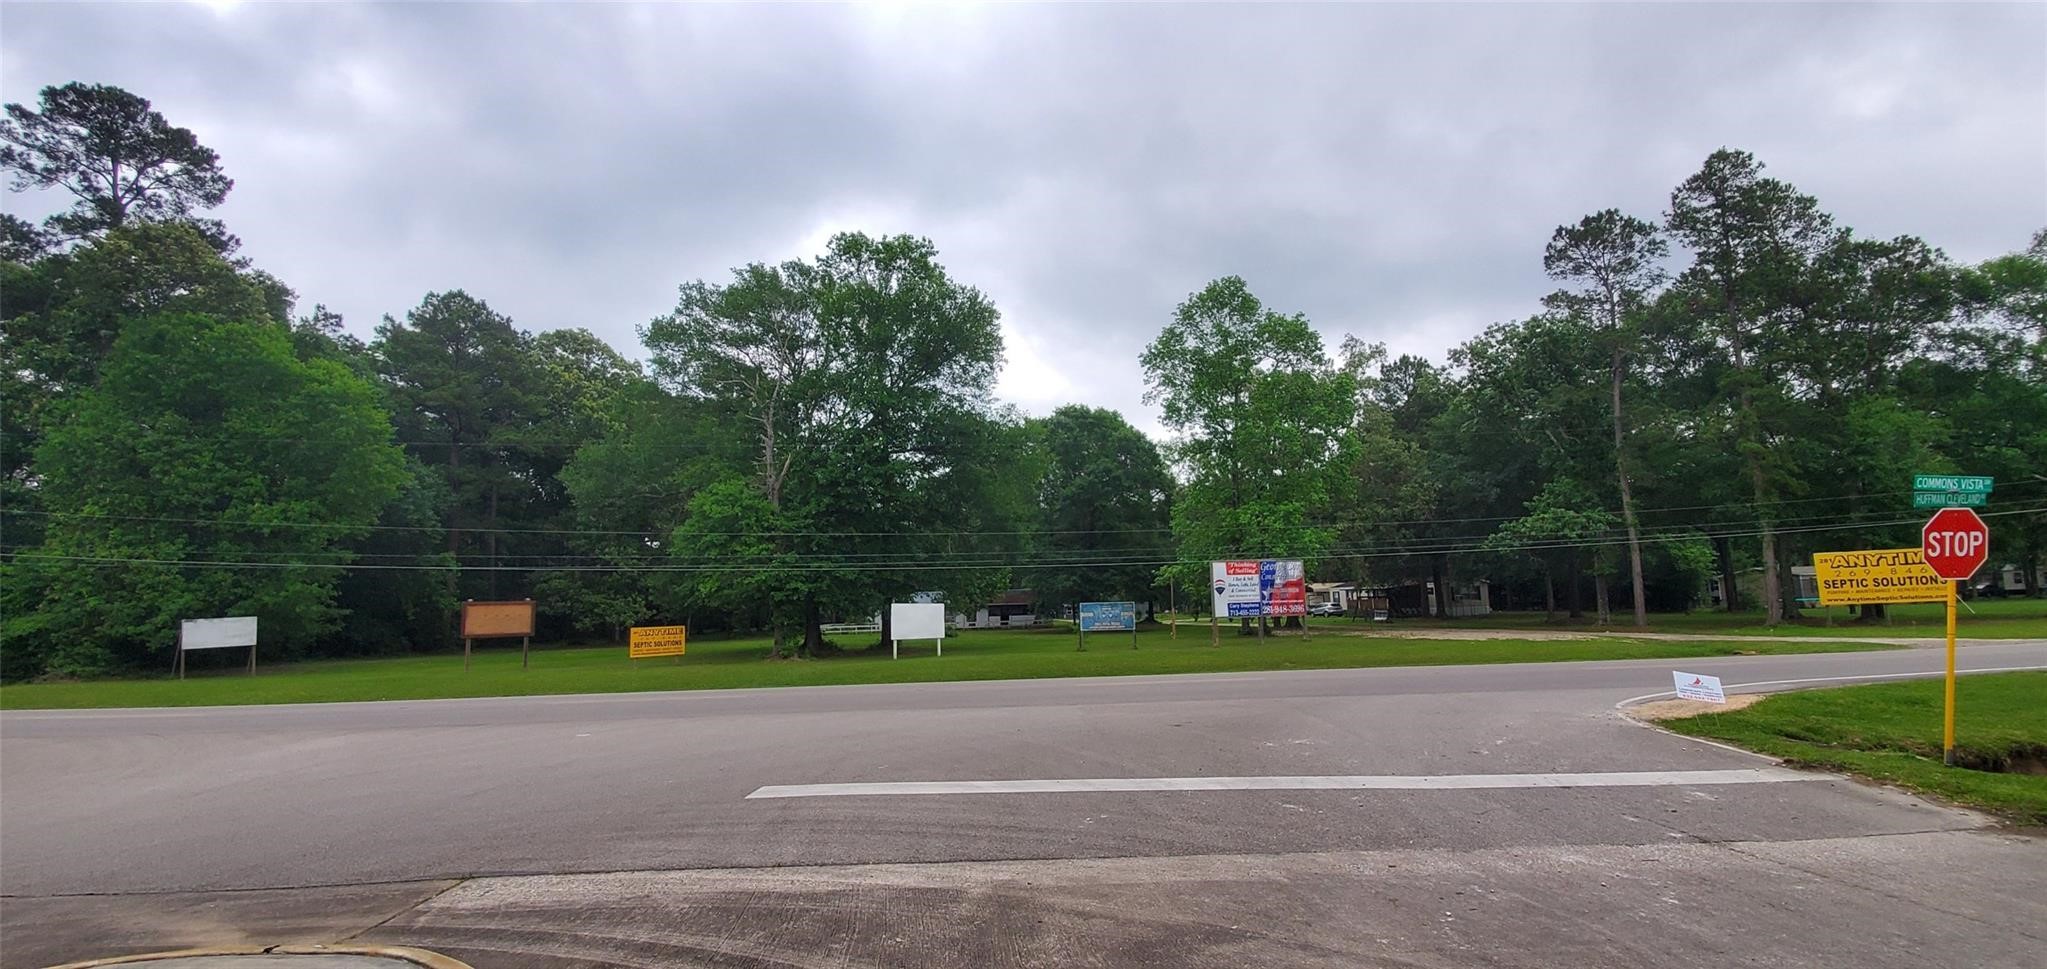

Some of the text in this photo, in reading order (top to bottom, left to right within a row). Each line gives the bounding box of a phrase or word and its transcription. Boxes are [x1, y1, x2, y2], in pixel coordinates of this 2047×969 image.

[1917, 478, 1958, 489] COMMONS
[1961, 479, 1984, 490] VISTA
[1916, 493, 1945, 504] HUFFMAN
[1947, 494, 1980, 504] CLEVELAND
[1927, 531, 1984, 557] STOP
[1831, 551, 1925, 568] ANYTIM
[1824, 578, 1869, 589] SEPTIC
[639, 628, 683, 636] ANYTIME
